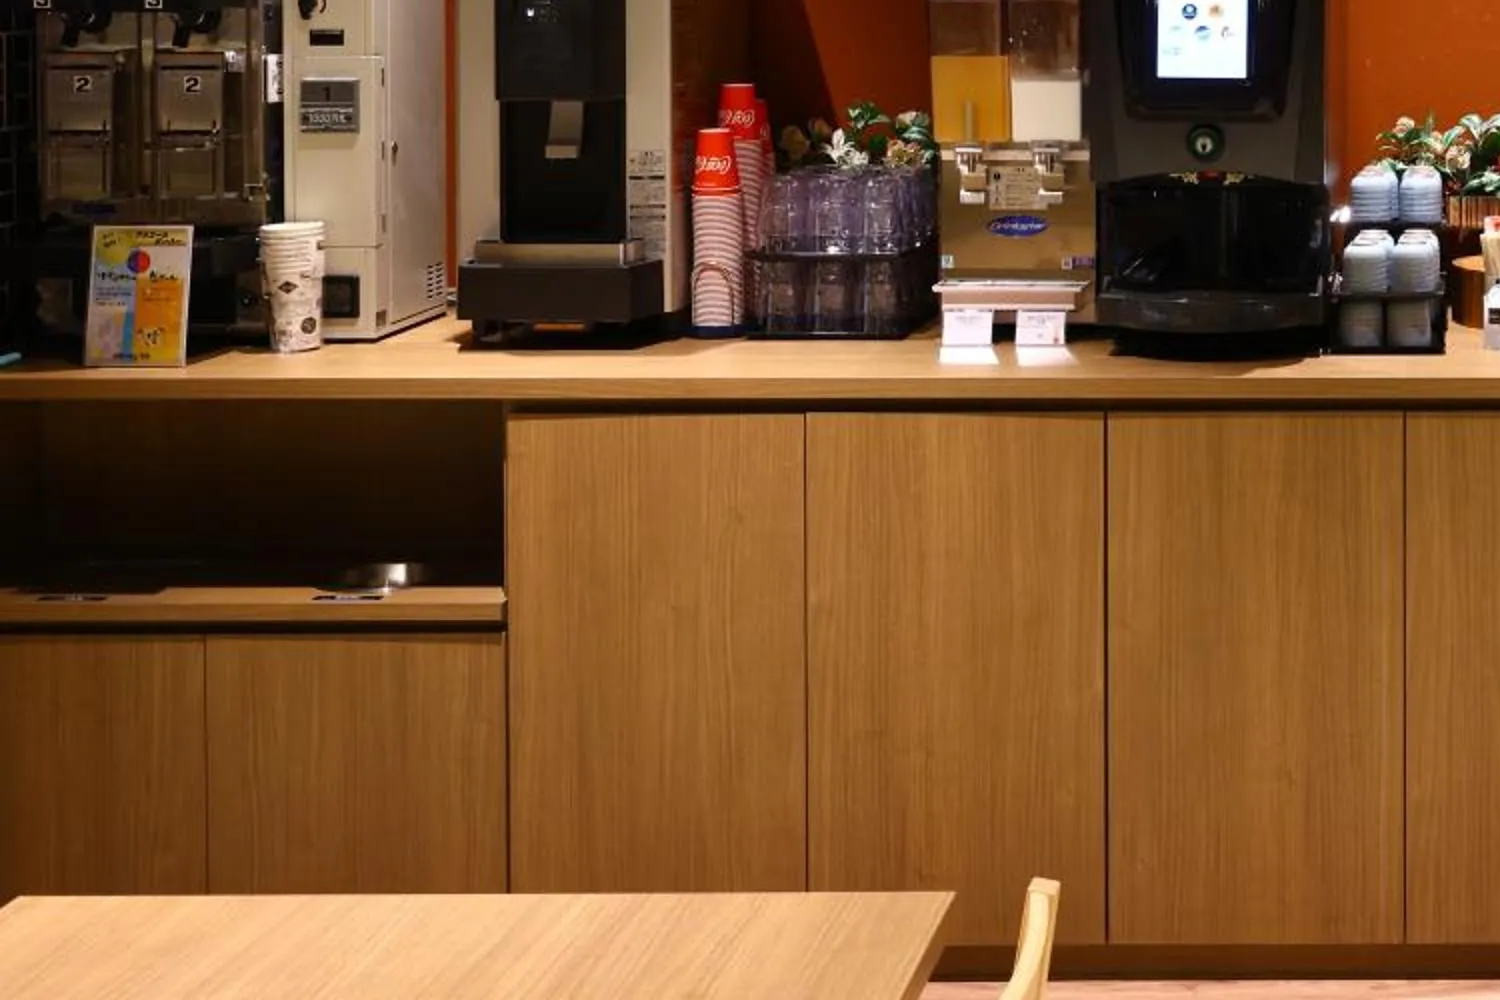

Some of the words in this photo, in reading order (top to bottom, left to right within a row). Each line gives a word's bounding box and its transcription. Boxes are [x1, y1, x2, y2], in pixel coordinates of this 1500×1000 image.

[76, 77, 91, 92] 2
[185, 77, 199, 92] 2
[321, 86, 331, 101] 1
